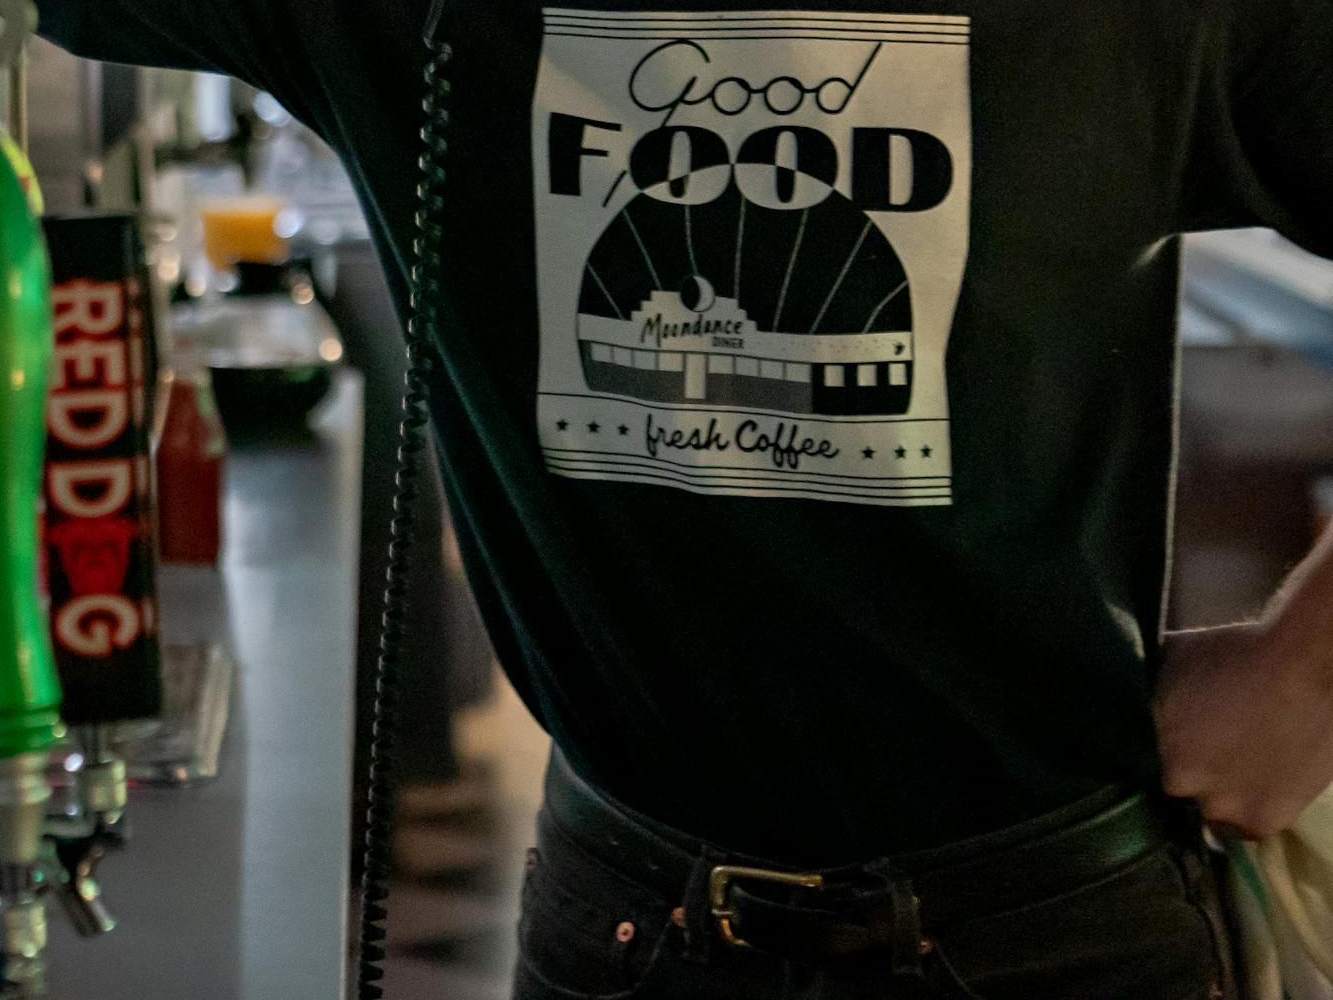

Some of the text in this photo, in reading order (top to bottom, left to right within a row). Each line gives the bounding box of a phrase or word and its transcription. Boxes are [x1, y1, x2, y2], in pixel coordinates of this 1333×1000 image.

[622, 38, 883, 140] Good
[548, 111, 954, 213] FOOD
[640, 313, 743, 348] Moondance
[47, 280, 141, 658] RED DG
[645, 413, 839, 469] fresh Coffee
